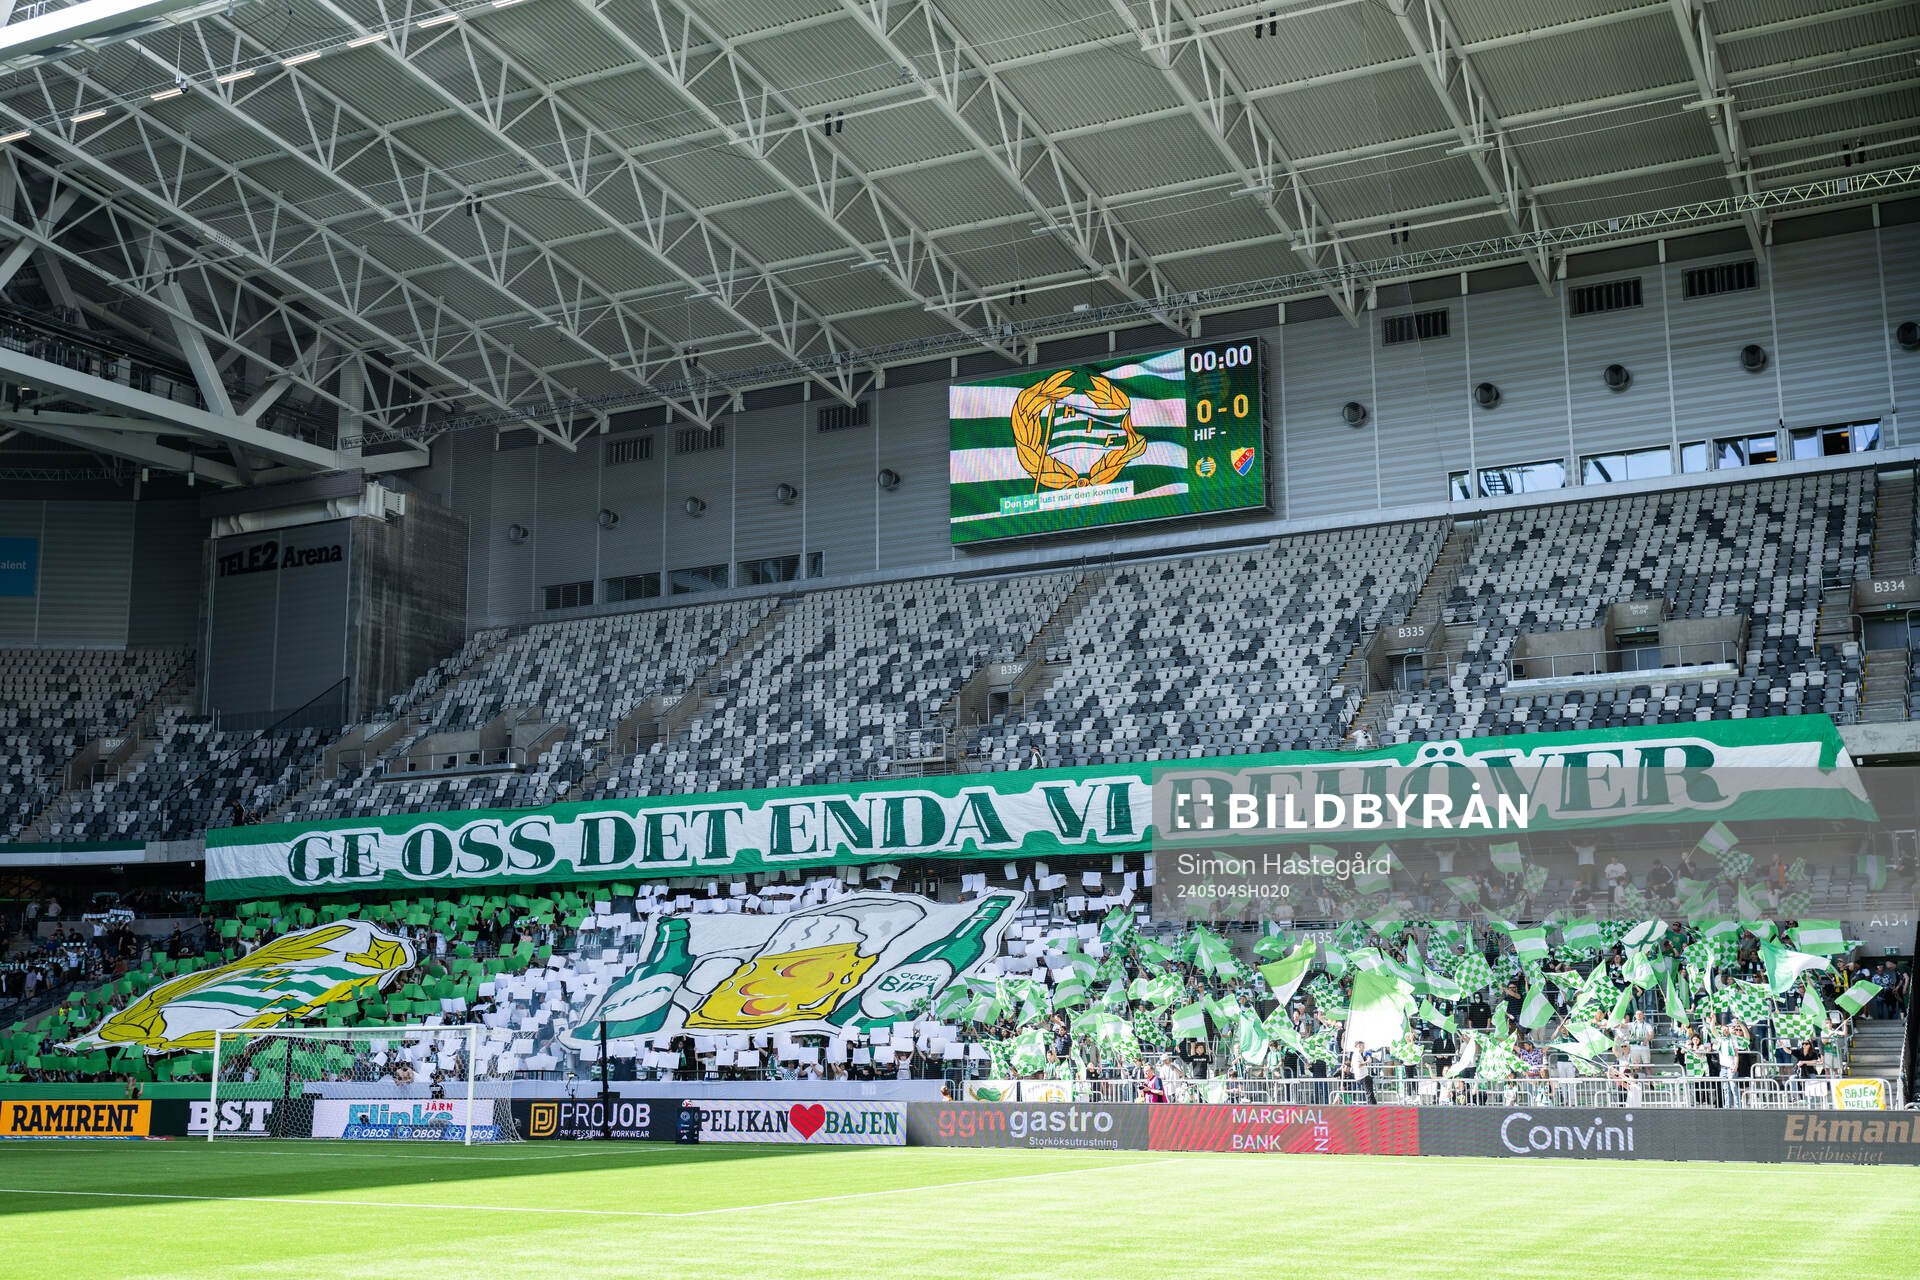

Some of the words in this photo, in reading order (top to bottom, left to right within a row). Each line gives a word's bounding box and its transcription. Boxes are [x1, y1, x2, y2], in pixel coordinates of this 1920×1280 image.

[1190, 345, 1252, 373] 00:00
[1197, 399, 1212, 423] 0
[1233, 394, 1249, 418] 0
[1194, 427, 1216, 441] HIF
[1074, 490, 1091, 499] den
[1092, 486, 1129, 497] kommer
[219, 541, 278, 577] TELE2
[281, 545, 342, 569] Arena
[1874, 581, 1906, 593] B334
[1398, 626, 1425, 639] B335
[1000, 664, 1023, 675] B336
[288, 831, 382, 882] GE
[402, 820, 556, 876] OSS
[577, 808, 744, 867] DET
[767, 793, 1017, 856] ENDA
[1039, 781, 1136, 838] VI
[1870, 912, 1908, 927] A134
[1844, 1087, 1877, 1099] BAJEN
[426, 1101, 453, 1111] JÄRN
[11, 1104, 139, 1132] RAMIRENT
[187, 1101, 272, 1131] BST
[700, 1109, 789, 1133] PELIKAN
[824, 1110, 900, 1136] BAJEN
[362, 1129, 390, 1138] OBOS
[411, 1129, 442, 1138] OBOS
[1501, 1112, 1634, 1154] Convini
[1029, 1135, 1118, 1148] Storköksutrustning
[1232, 1134, 1281, 1150] BANK
